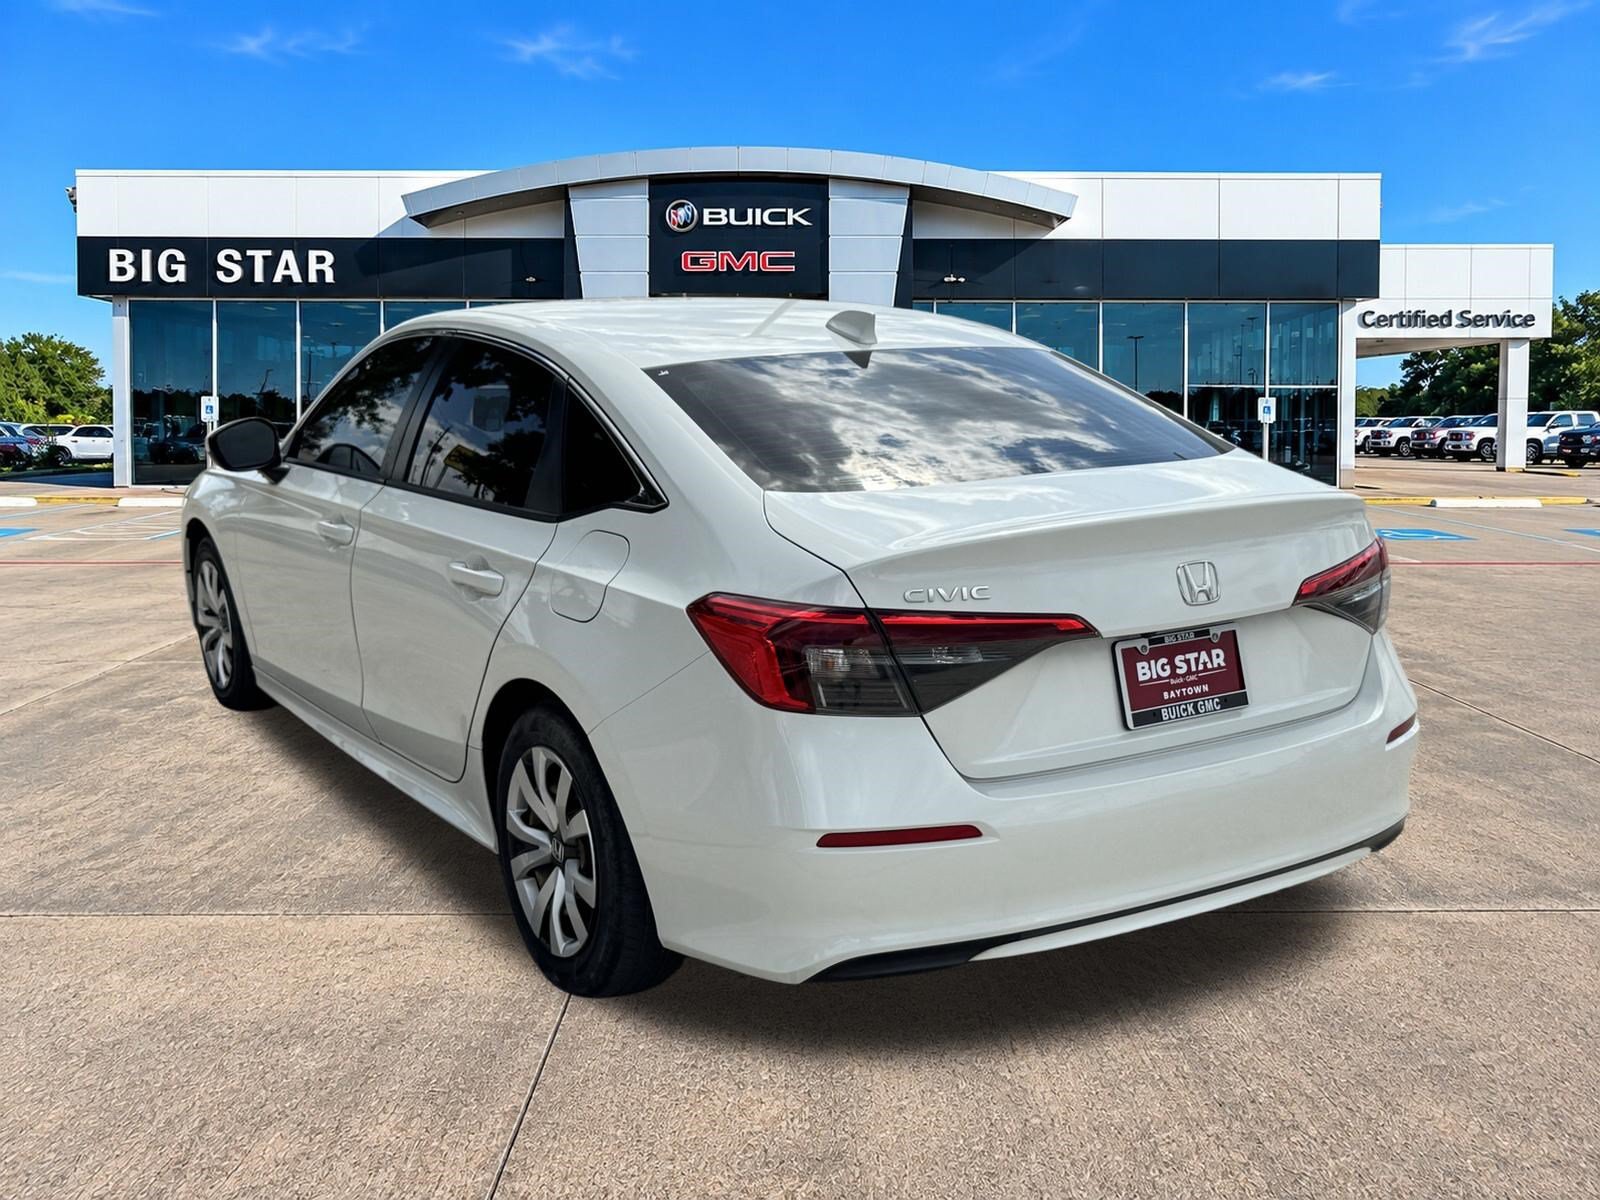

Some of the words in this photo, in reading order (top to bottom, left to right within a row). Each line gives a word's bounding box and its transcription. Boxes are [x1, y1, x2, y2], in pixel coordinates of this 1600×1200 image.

[702, 207, 813, 226] BUICK
[108, 248, 187, 283] BIG
[216, 248, 336, 283] STAR
[681, 250, 796, 272] GMC
[1358, 309, 1453, 329] Certified
[1454, 309, 1537, 329] Service
[903, 585, 992, 604] CIVIC
[1164, 634, 1177, 643] BIG
[1177, 631, 1195, 641] STAR
[1136, 658, 1171, 682] BIG
[1174, 648, 1226, 674] STAR
[1163, 684, 1209, 699] BAYTOWN
[1161, 702, 1196, 721] BUICK
[1197, 697, 1222, 714] GMC
